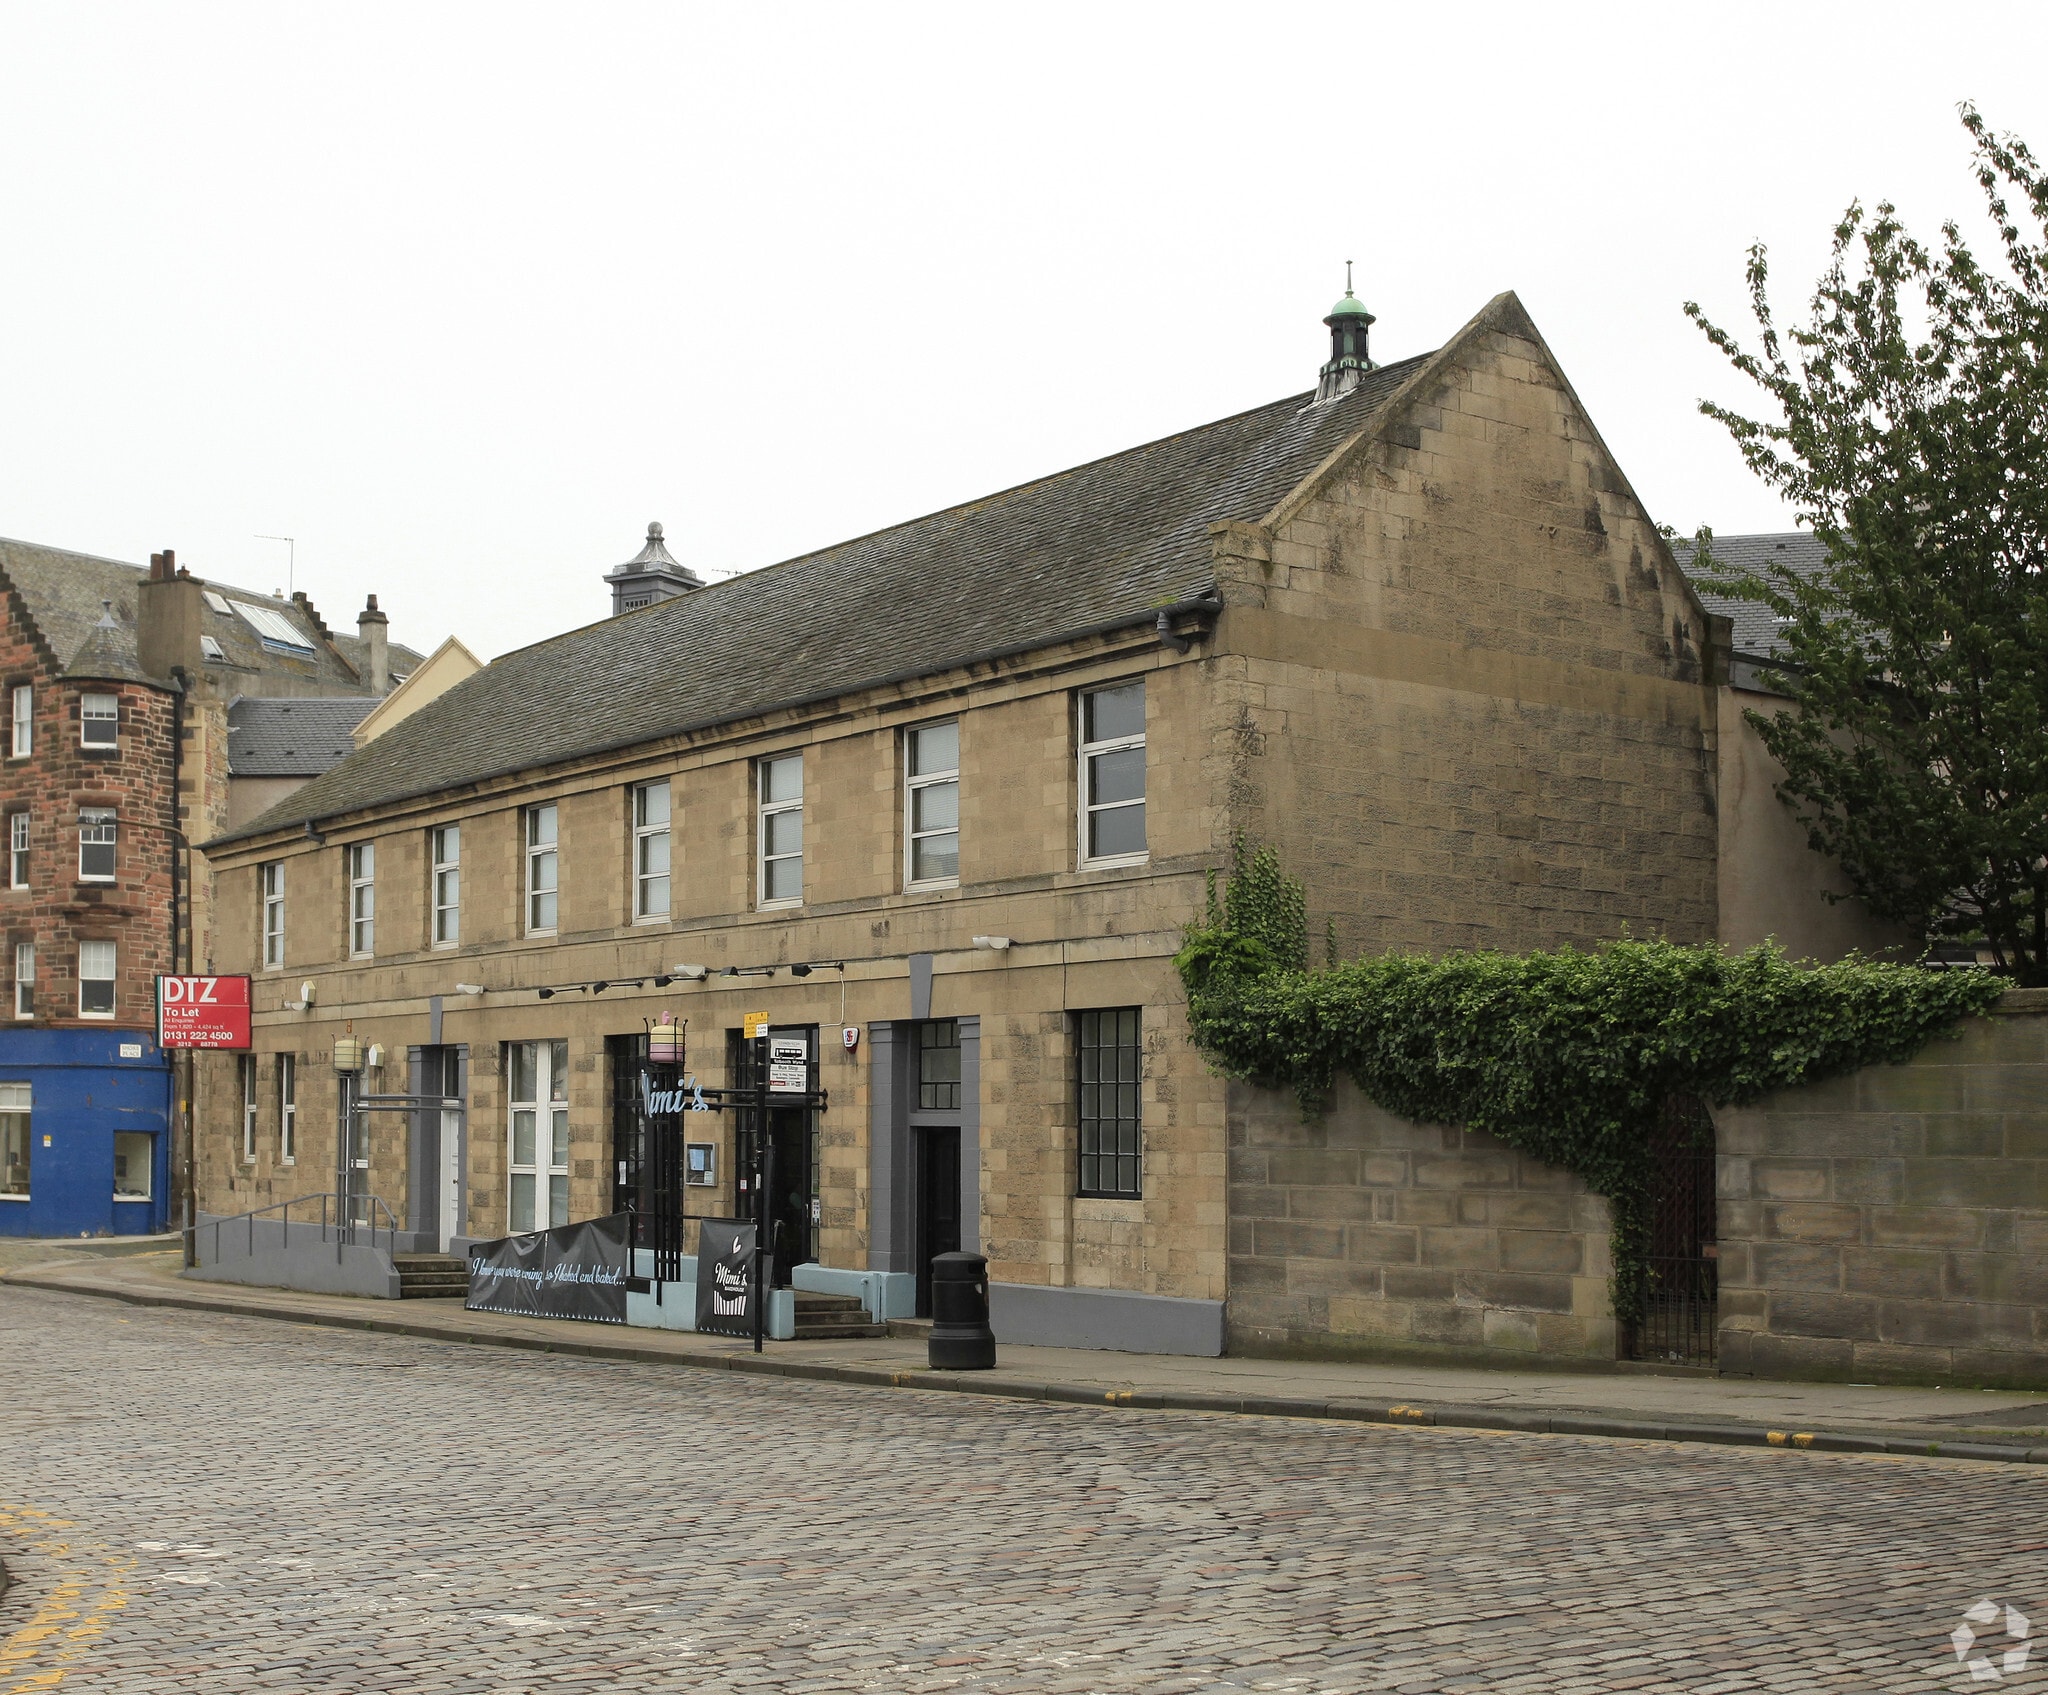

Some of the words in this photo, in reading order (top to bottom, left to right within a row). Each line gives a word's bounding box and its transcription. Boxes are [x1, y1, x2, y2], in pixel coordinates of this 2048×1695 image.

[164, 977, 218, 1003] DTZ
[164, 1007, 179, 1017] To
[181, 1007, 200, 1017] Let
[164, 1031, 187, 1040] 0131
[189, 1031, 208, 1040] 222
[209, 1031, 233, 1040] 4500
[472, 1257, 481, 1276] I
[492, 1267, 505, 1286] you
[504, 1267, 521, 1278] were
[545, 1269, 554, 1281] so
[553, 1263, 563, 1283] I
[559, 1263, 581, 1284] baked
[579, 1264, 596, 1285] and
[715, 1262, 747, 1286] Mimi's
